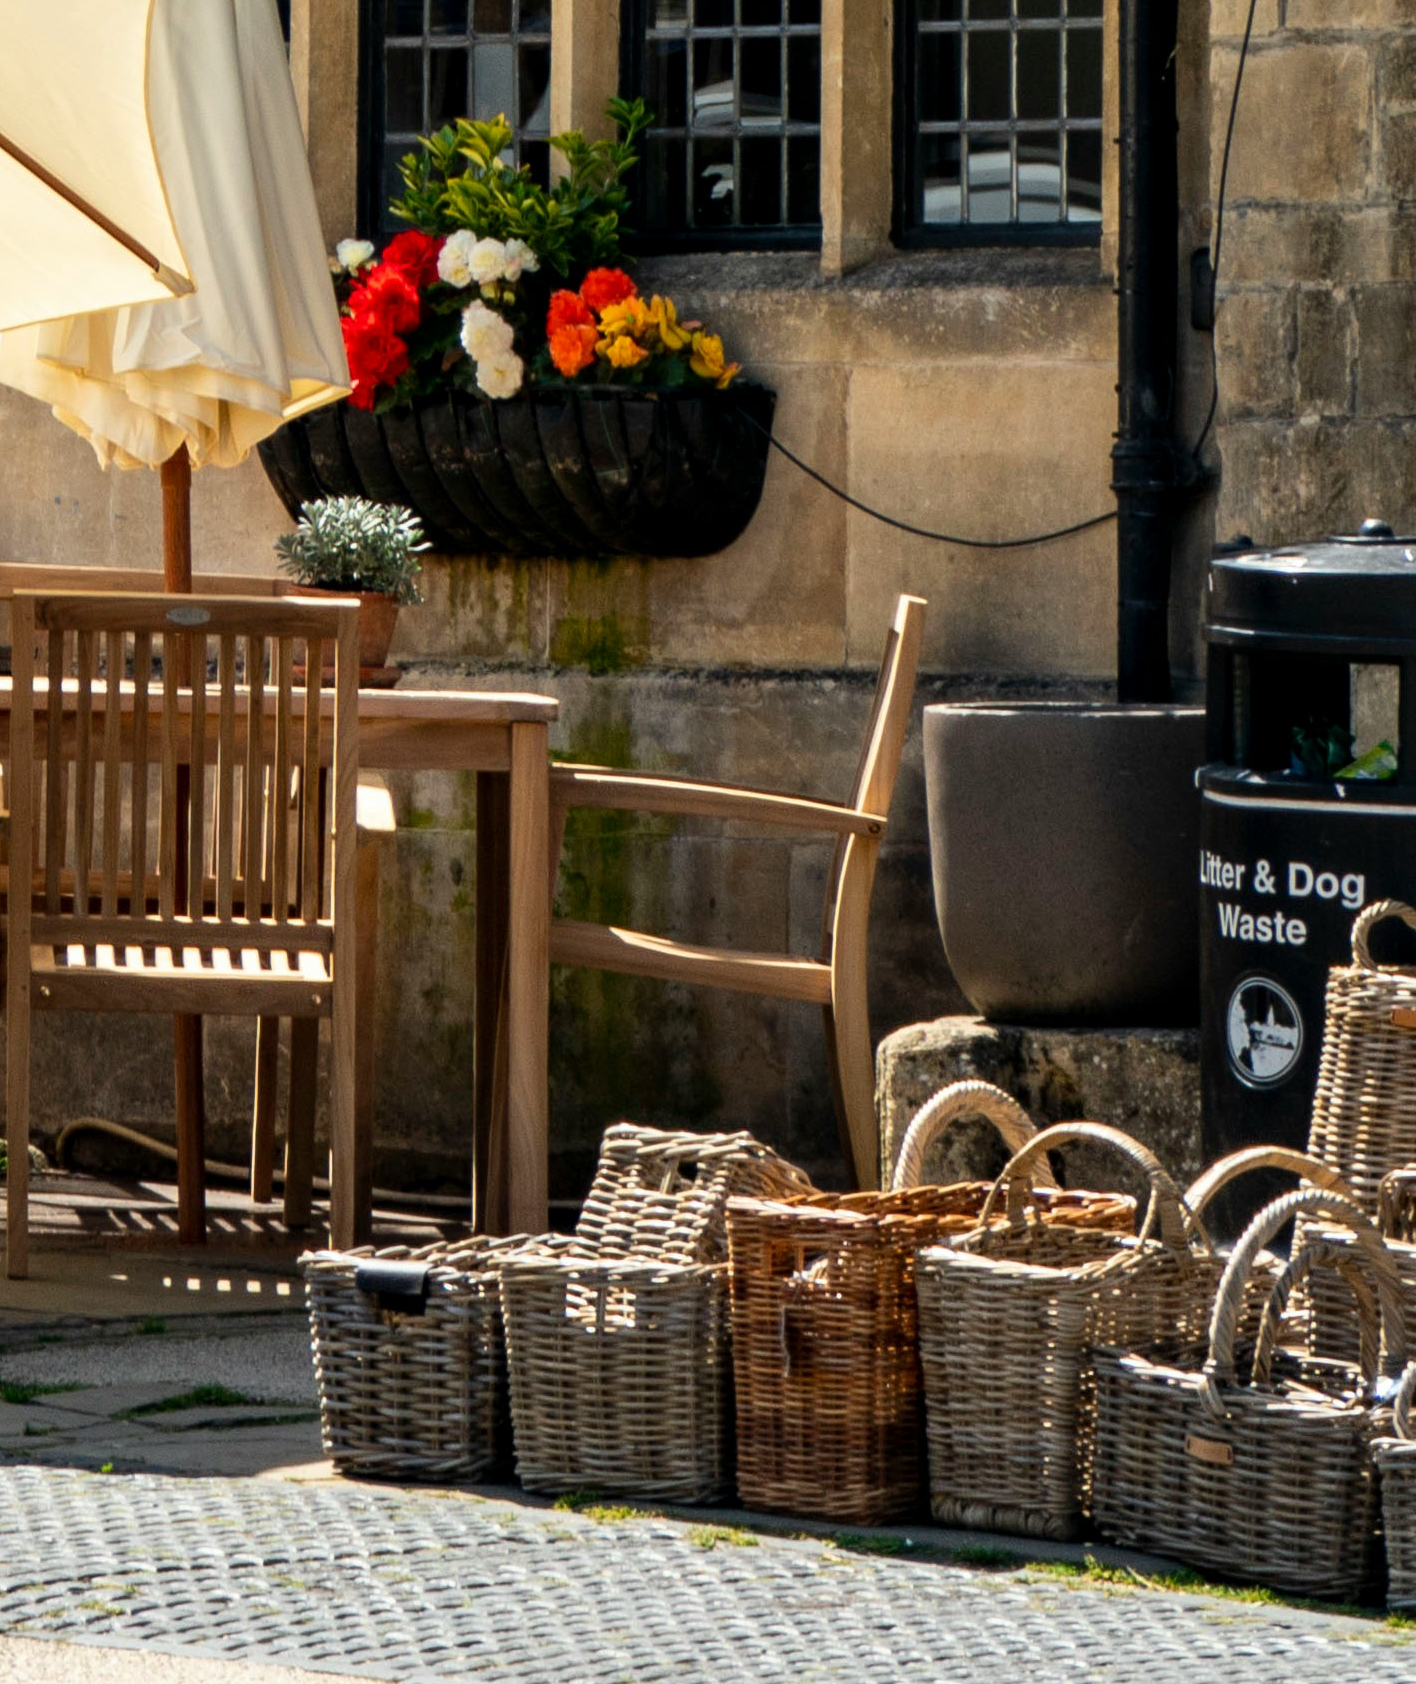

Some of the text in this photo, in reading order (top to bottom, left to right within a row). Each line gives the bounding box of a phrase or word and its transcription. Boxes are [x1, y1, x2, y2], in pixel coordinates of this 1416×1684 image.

[1199, 850, 1365, 910] Litter & Dog
[1218, 902, 1307, 946] Waste
